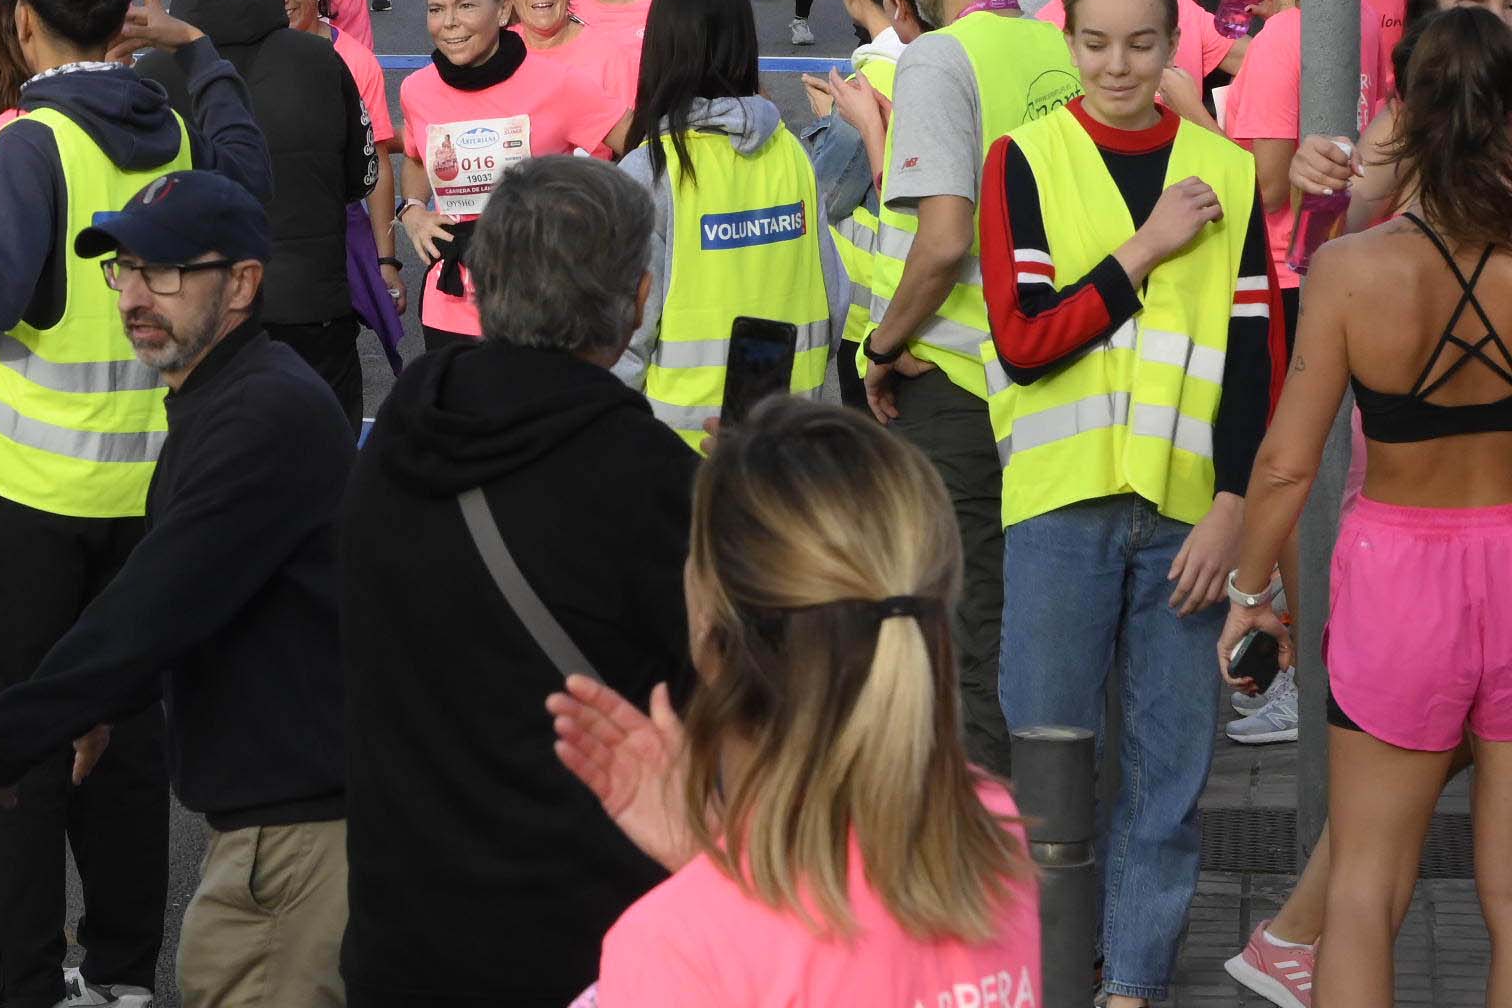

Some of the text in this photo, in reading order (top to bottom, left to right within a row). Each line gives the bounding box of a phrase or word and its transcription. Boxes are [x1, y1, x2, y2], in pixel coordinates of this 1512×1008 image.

[461, 155, 496, 171] 016
[446, 199, 476, 208] OYSHO
[703, 212, 803, 242] VOLUNTARIS
